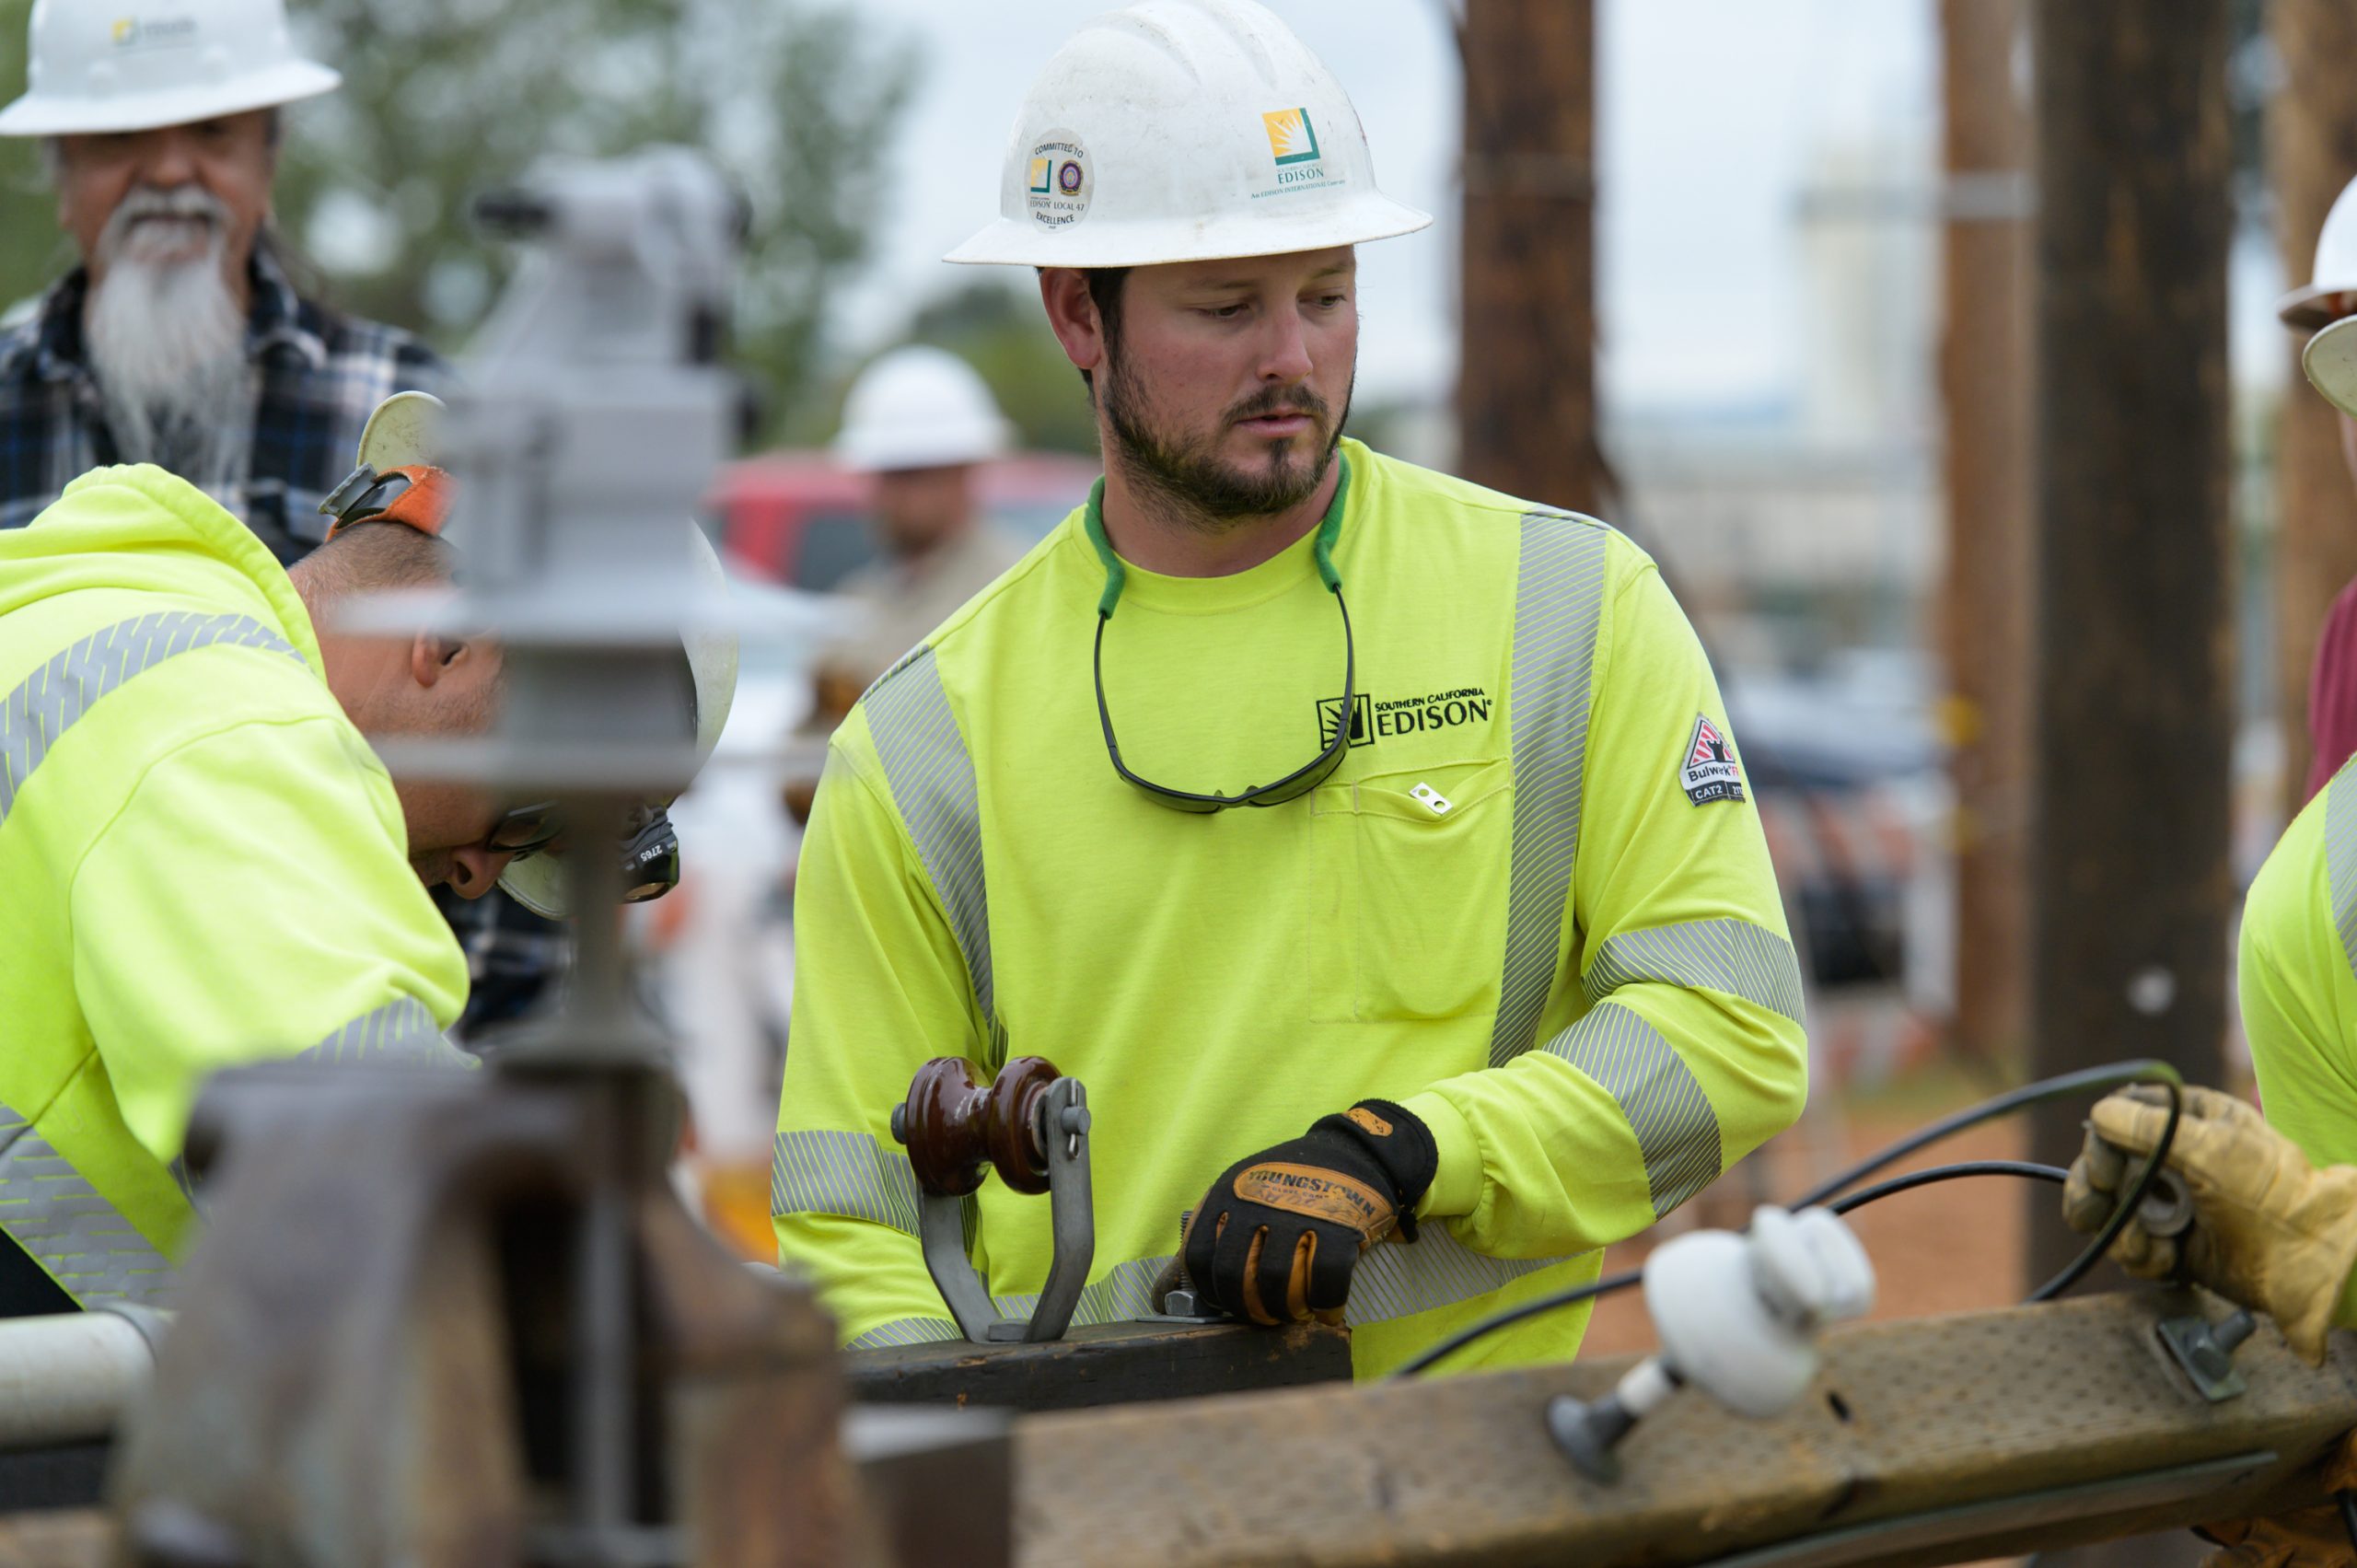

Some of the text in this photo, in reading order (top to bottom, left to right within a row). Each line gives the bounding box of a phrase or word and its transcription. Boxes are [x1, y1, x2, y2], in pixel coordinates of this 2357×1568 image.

[1035, 142, 1084, 158] COMMITTED TO
[1278, 167, 1324, 184] EDISON
[1260, 188, 1283, 197] EDISON
[1284, 180, 1326, 192] INTERNATIONAL
[1030, 200, 1085, 212] EDISON LOCAL 47
[1036, 211, 1075, 226] EXCELLENCE
[1375, 688, 1485, 713] SOUTHERN CALIFORNIA
[1695, 784, 1724, 799] CAT2
[640, 844, 663, 862] 2765
